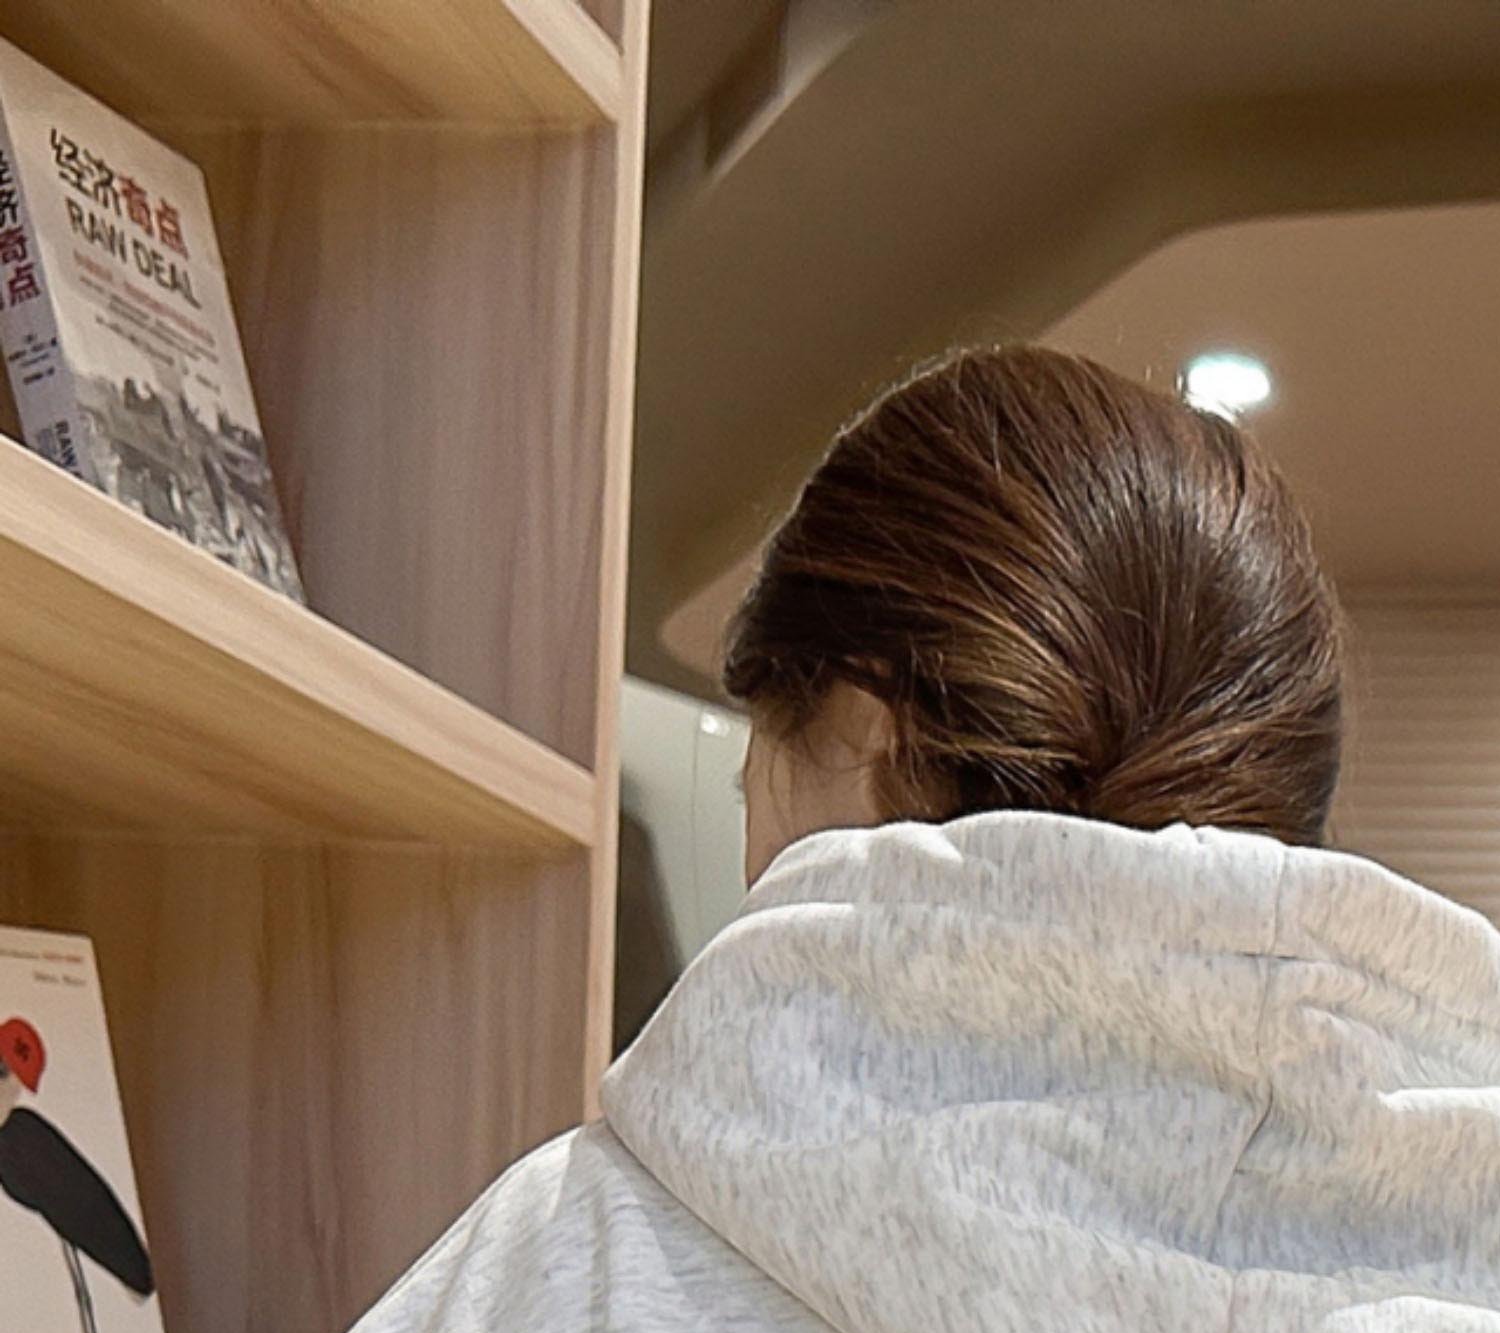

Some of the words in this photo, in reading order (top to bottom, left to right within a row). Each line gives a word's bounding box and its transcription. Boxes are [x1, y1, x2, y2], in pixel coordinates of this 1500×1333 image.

[65, 195, 127, 264] RAW
[131, 237, 203, 311] DEAL
[55, 420, 78, 467] RAW
